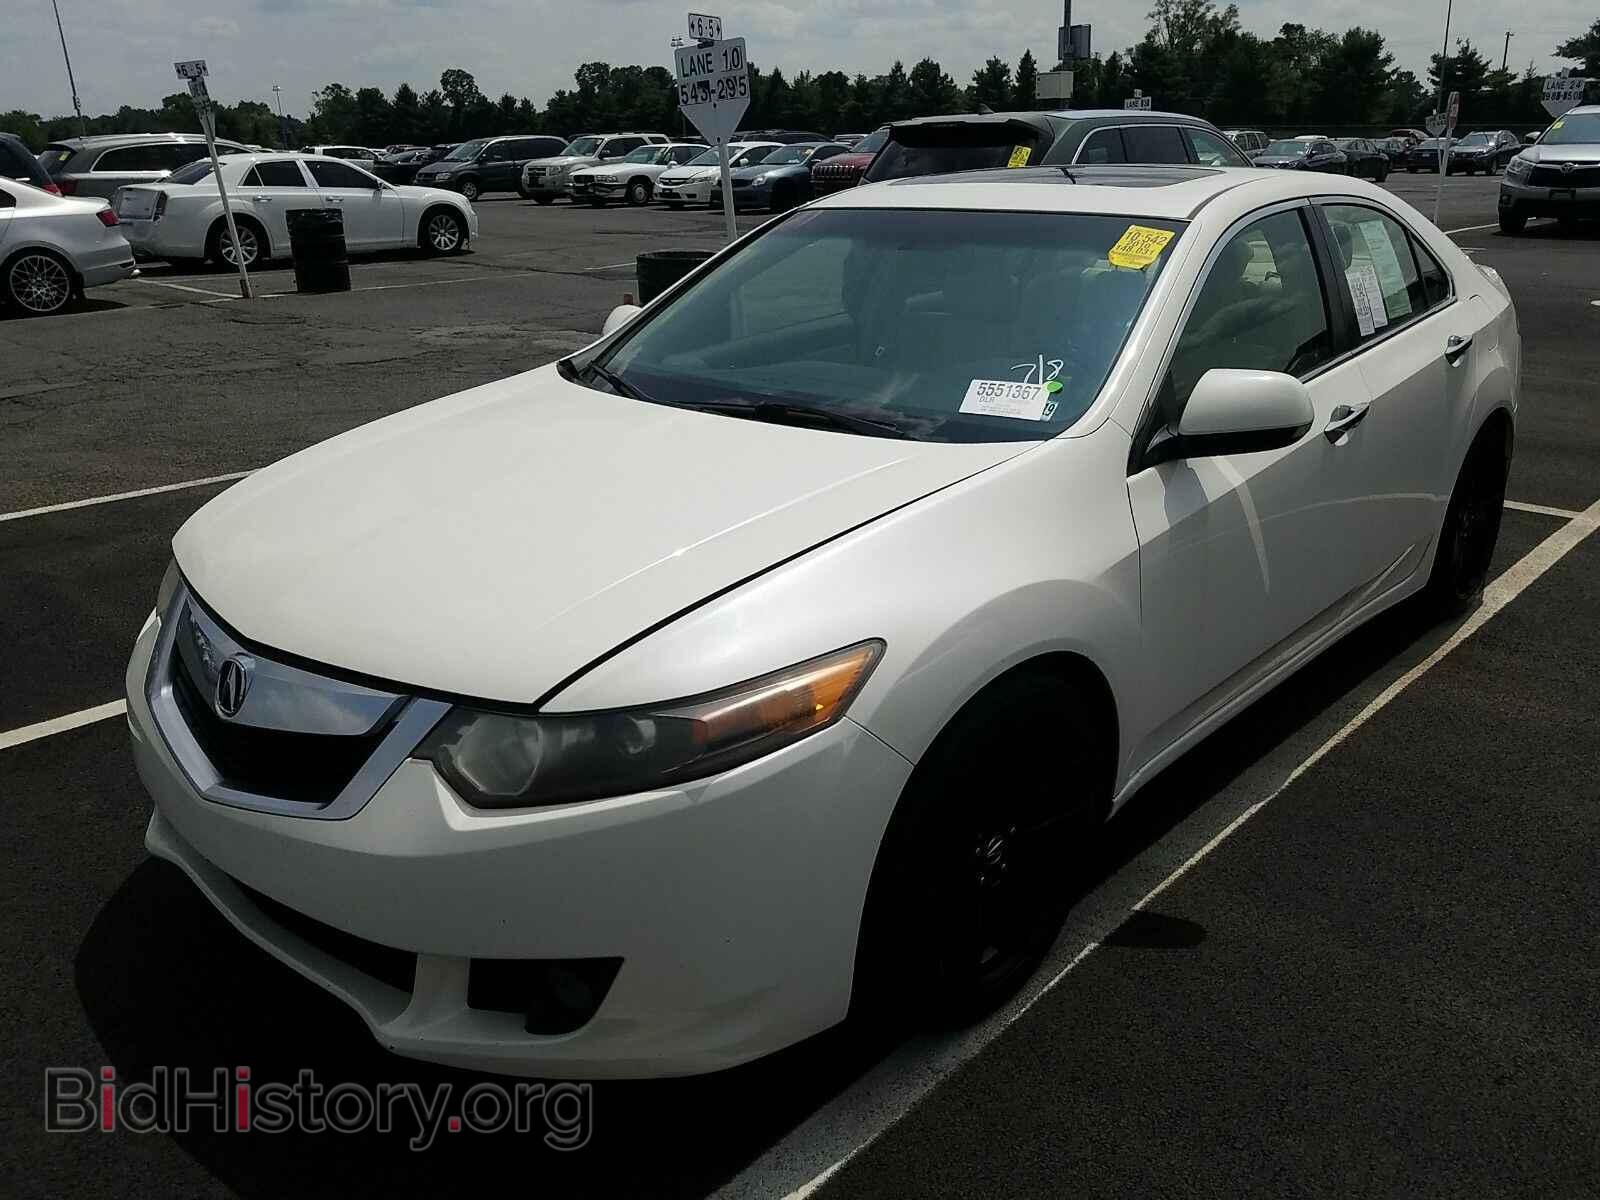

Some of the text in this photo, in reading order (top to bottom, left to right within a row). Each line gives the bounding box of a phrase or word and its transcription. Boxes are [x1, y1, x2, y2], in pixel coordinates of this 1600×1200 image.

[680, 47, 740, 78] LANE 10
[680, 76, 747, 104] 543-295
[1545, 79, 1566, 90] LANE
[976, 382, 1042, 401] 5551367
